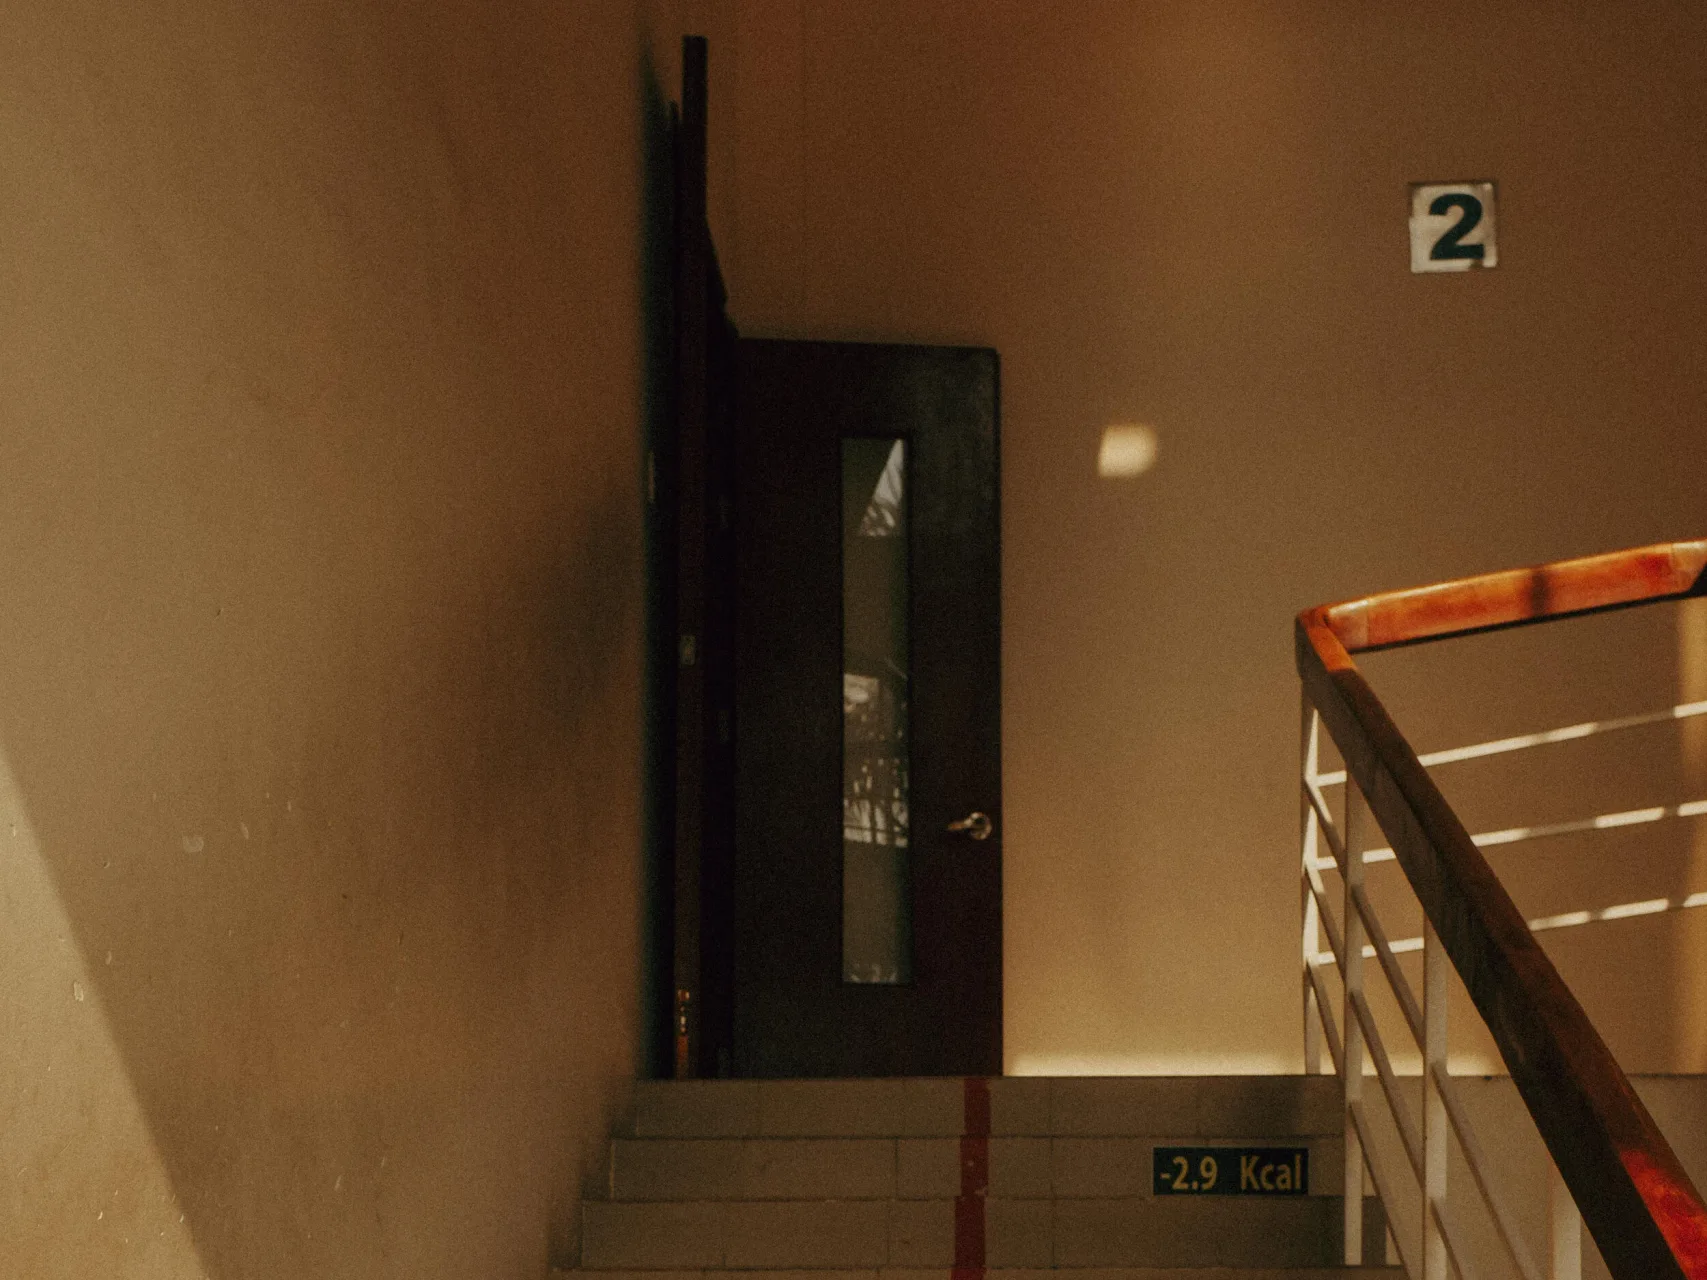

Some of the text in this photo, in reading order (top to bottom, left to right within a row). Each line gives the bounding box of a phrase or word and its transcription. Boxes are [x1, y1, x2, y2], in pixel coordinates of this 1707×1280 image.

[1429, 193, 1484, 261] 2
[1159, 1154, 1301, 1191] -2.9 Kcal
